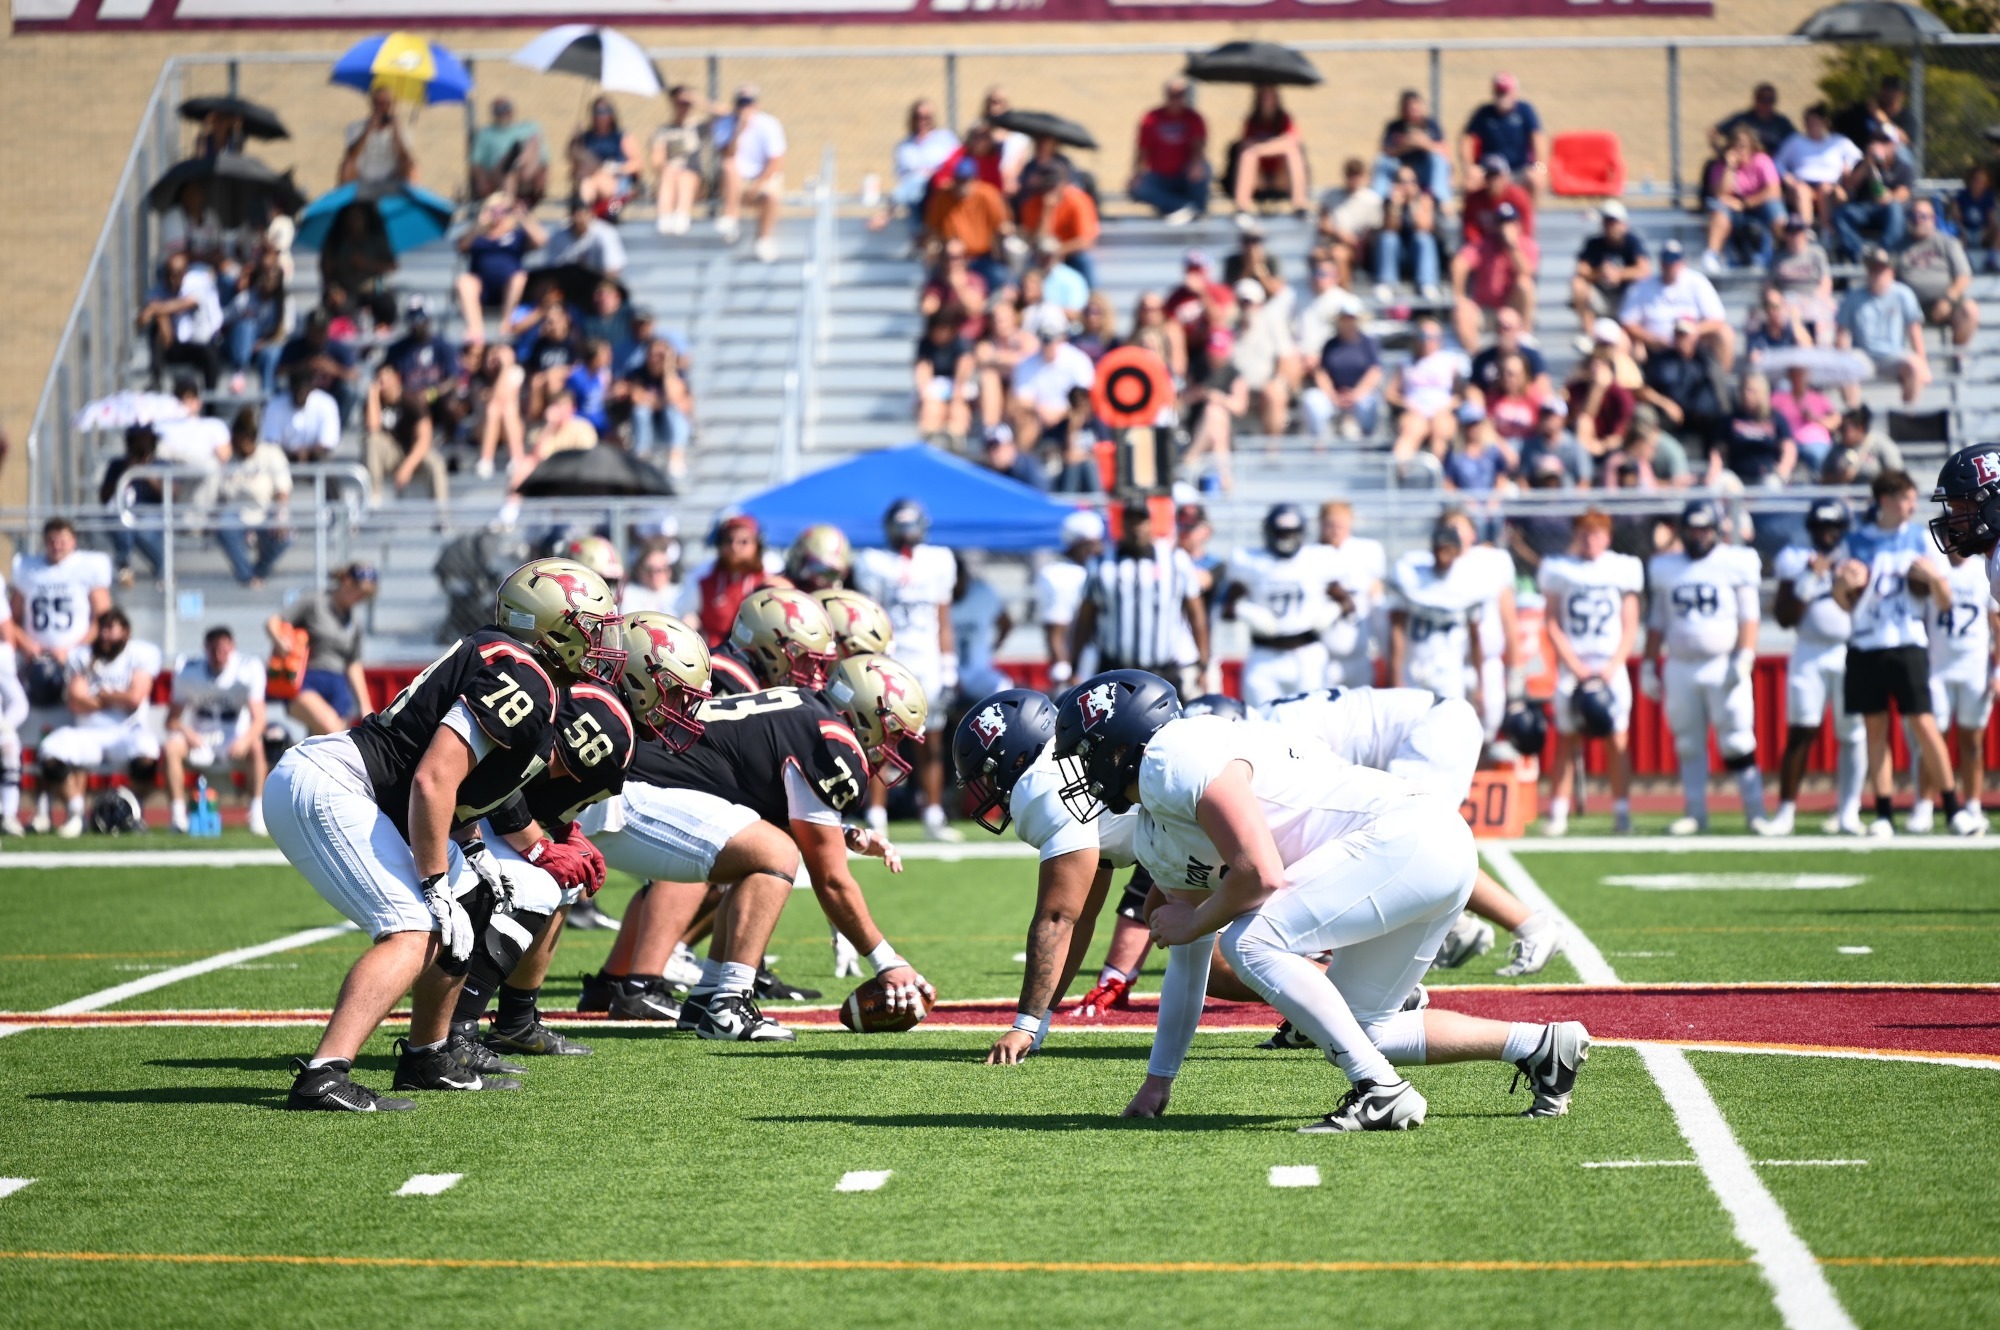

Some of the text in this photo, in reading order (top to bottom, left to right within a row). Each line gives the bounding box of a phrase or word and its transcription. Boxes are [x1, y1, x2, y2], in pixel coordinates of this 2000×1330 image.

[31, 596, 73, 632] 65
[1567, 591, 1613, 637] 52
[1672, 583, 1718, 618] 58
[480, 672, 534, 728] 78
[563, 712, 614, 767] 58
[818, 756, 859, 811] 73
[527, 842, 545, 863] NIKE
